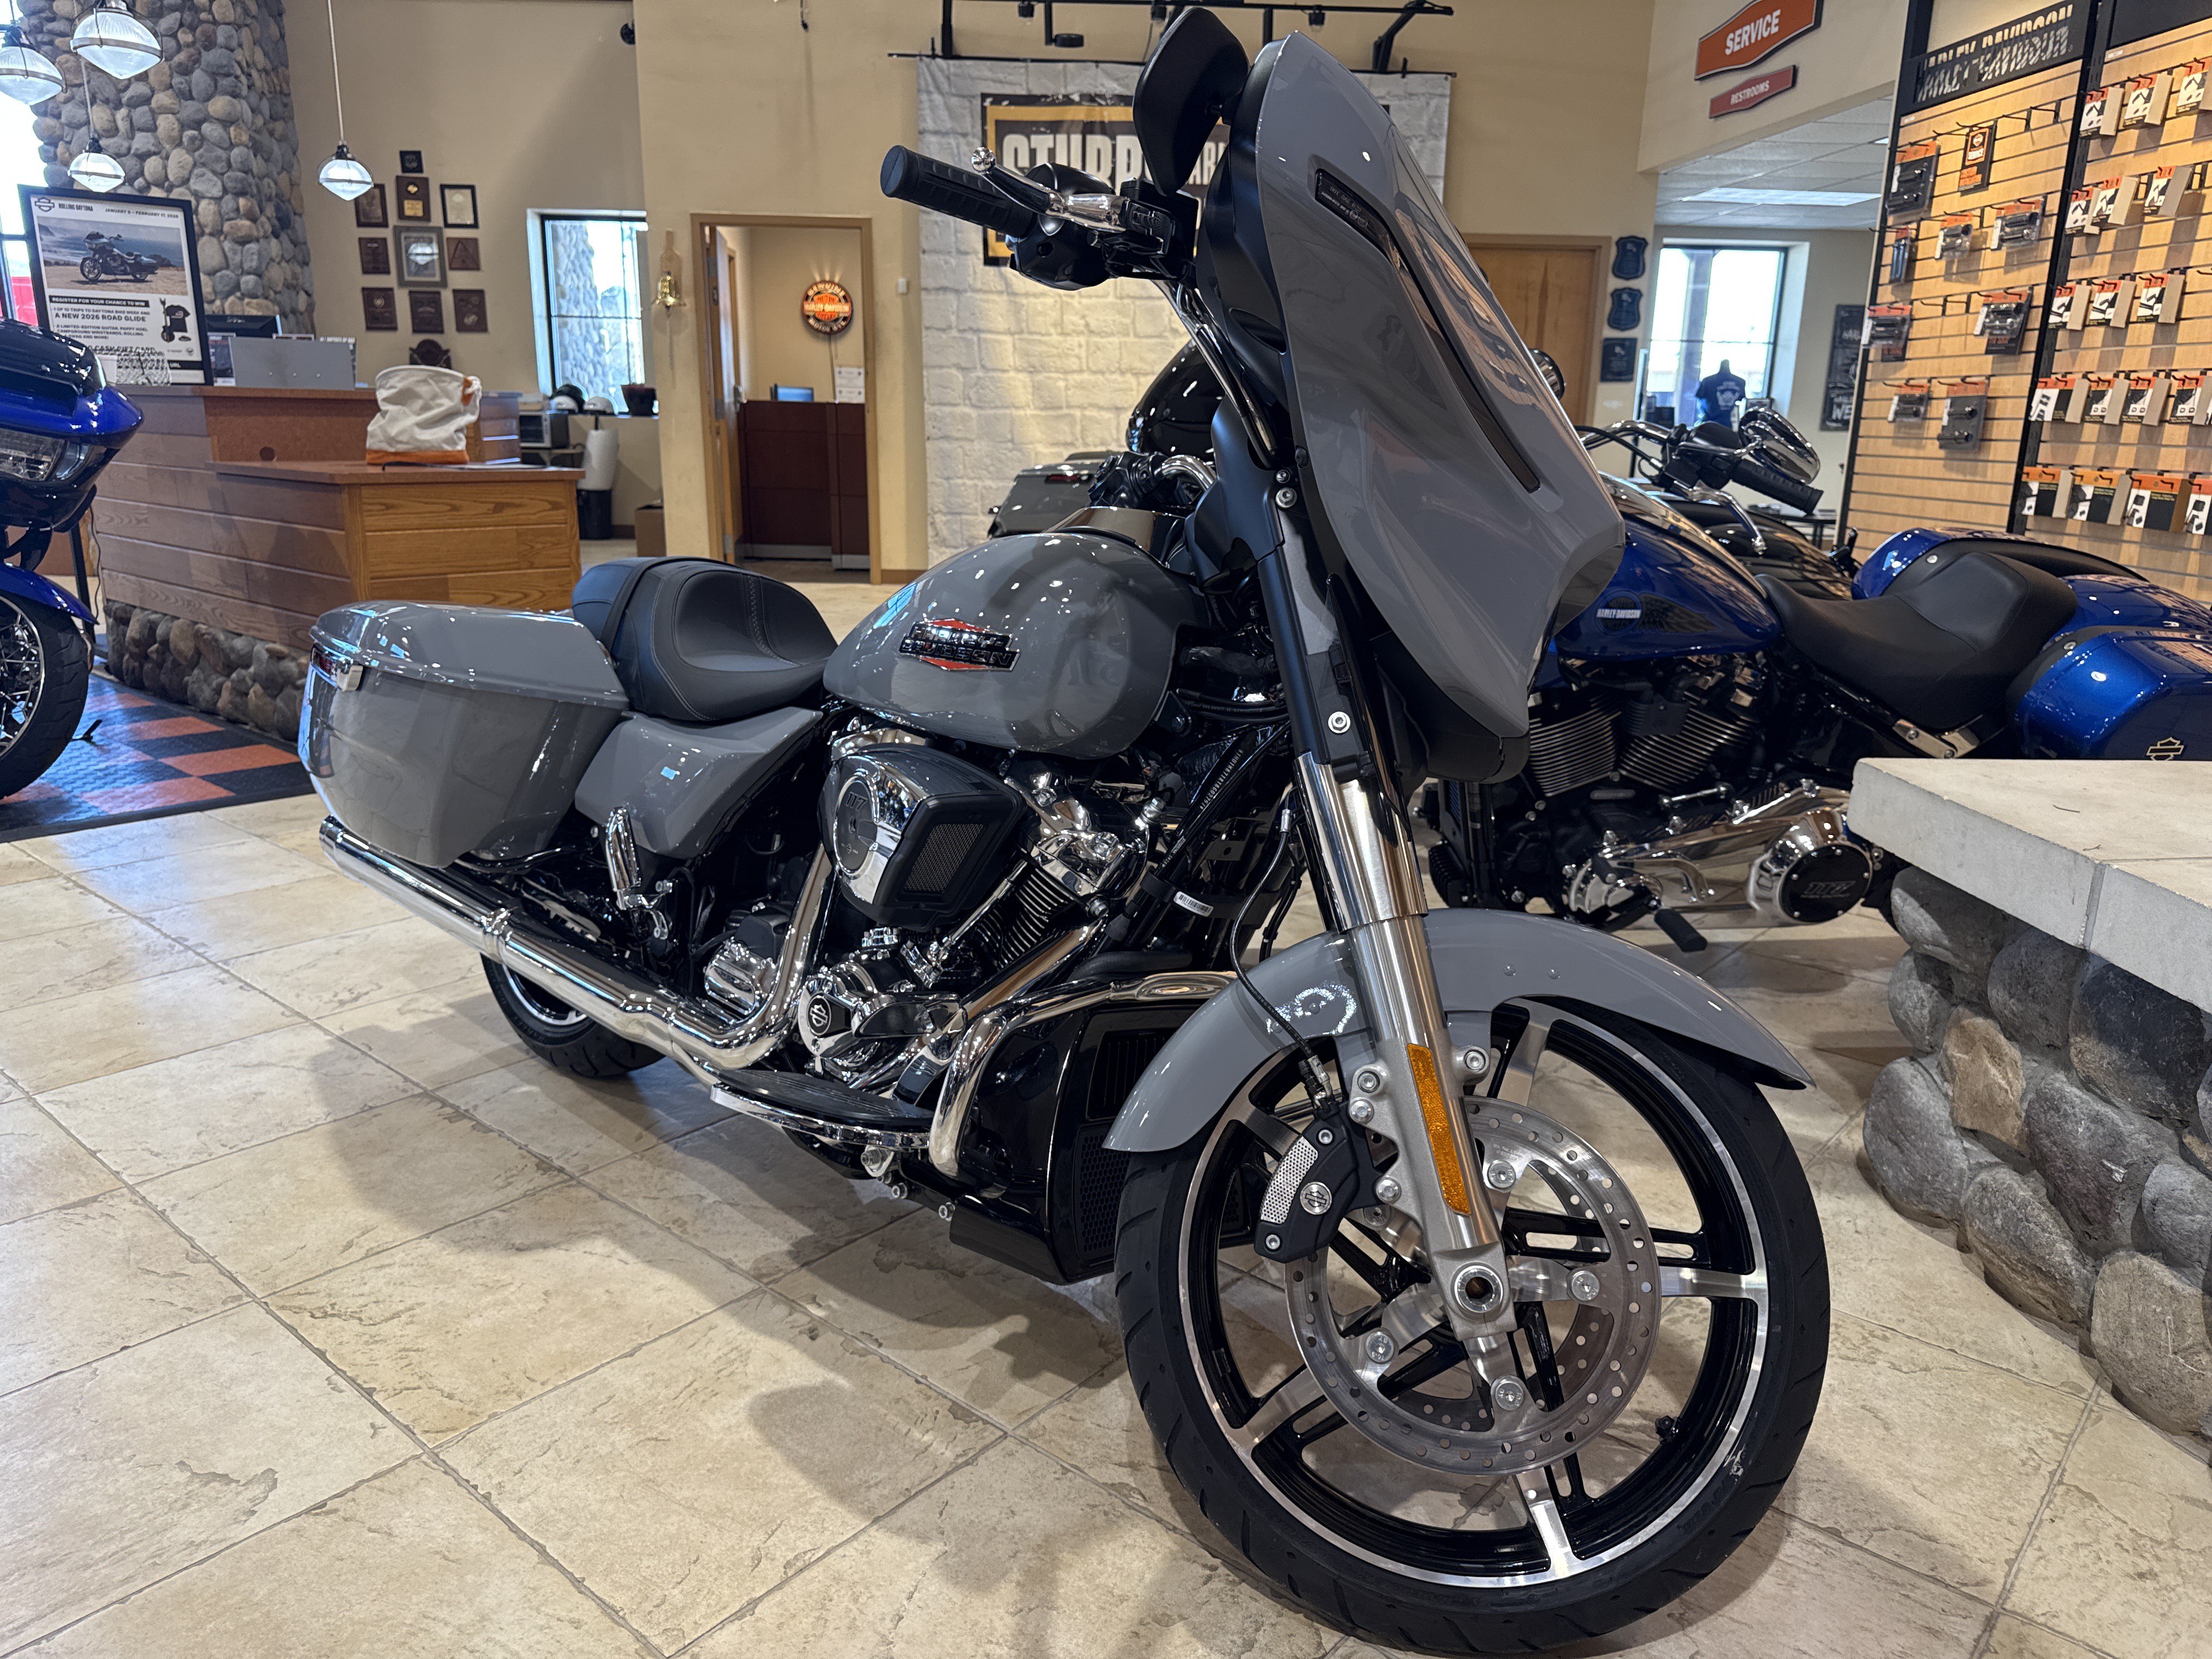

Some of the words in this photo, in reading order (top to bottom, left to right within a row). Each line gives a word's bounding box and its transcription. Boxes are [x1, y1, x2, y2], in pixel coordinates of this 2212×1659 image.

[1725, 9, 1781, 55] SERVICE
[1730, 80, 1770, 105] RESTROOMS
[76, 204, 93, 212] DAYTONA
[1596, 608, 1641, 619] HARLEY-DAVIDSON
[901, 639, 1012, 665] DAVIDSON
[845, 791, 868, 812] 117
